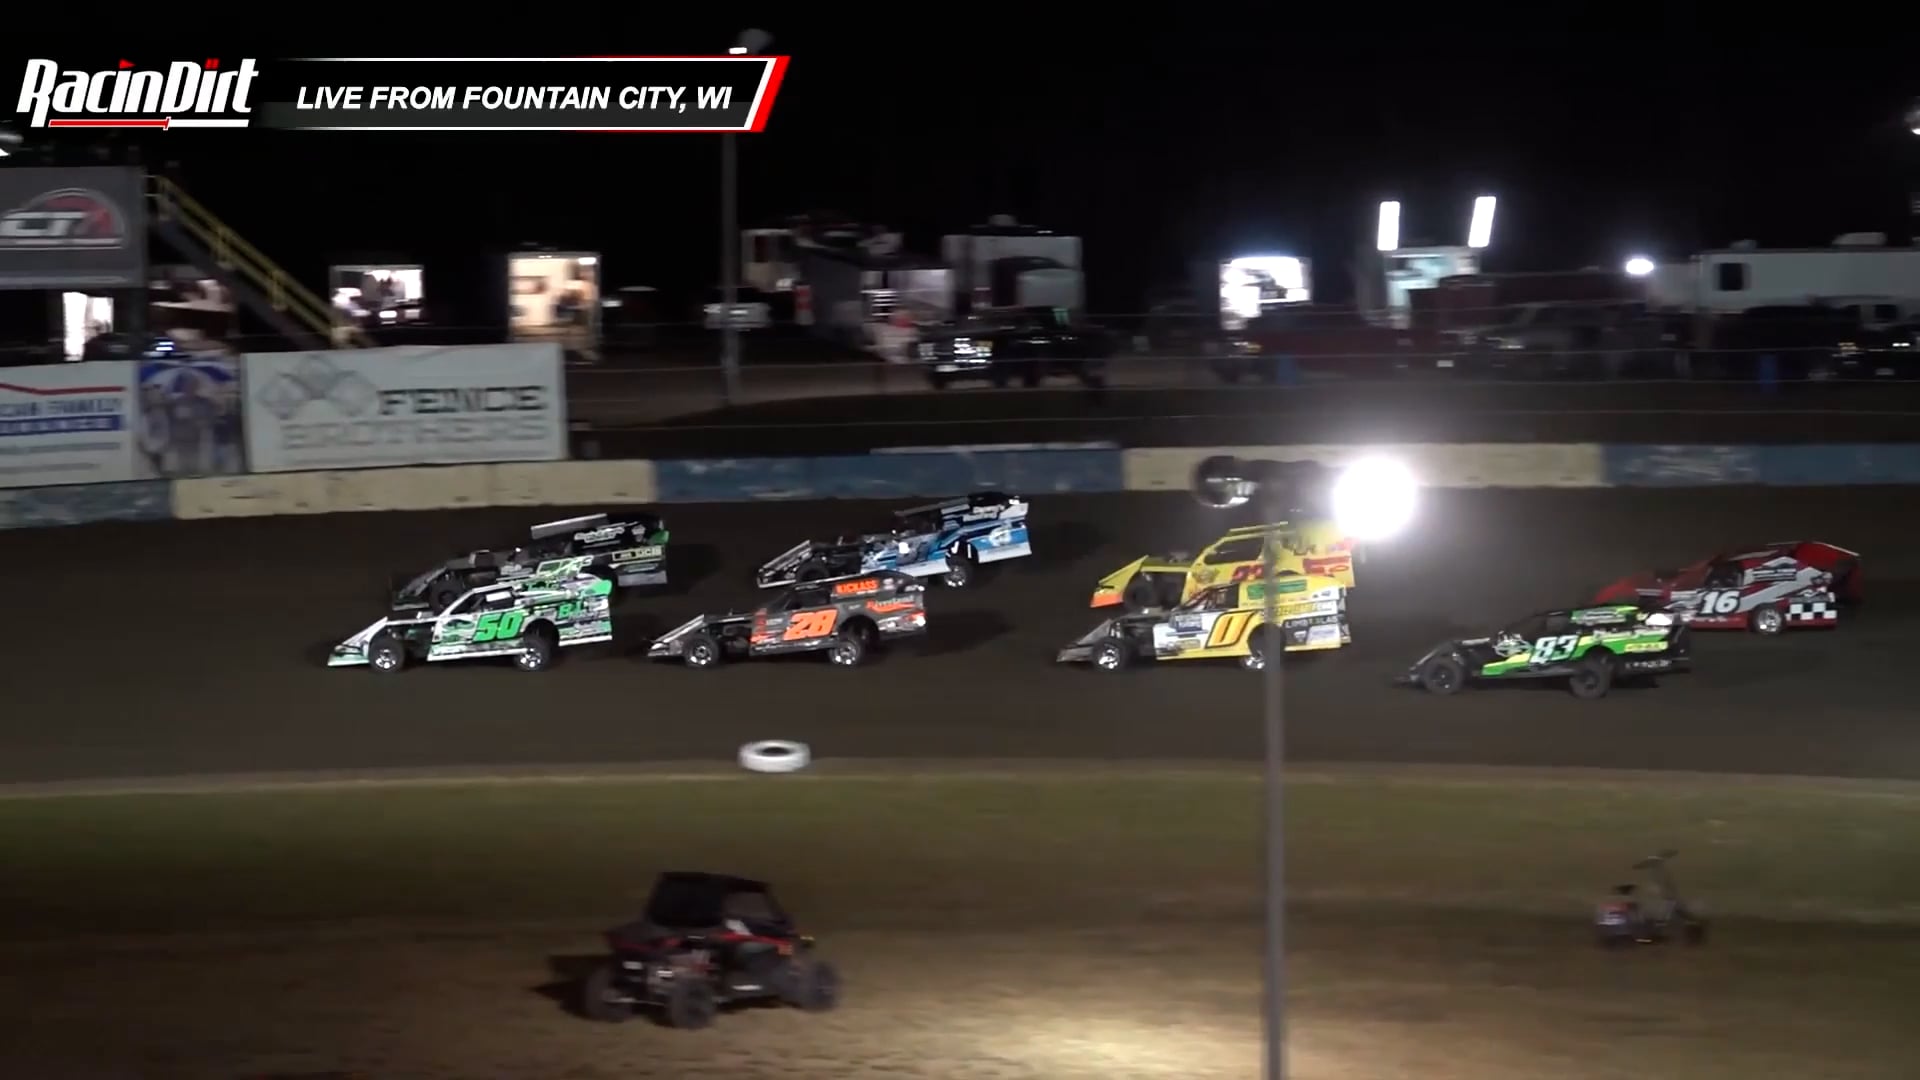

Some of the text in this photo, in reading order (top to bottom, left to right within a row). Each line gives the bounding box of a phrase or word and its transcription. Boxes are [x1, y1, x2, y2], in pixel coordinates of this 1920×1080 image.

[376, 386, 544, 415] FENCE
[1701, 591, 1740, 614] 16
[472, 612, 524, 641] 50
[783, 608, 838, 641] 28
[1530, 635, 1579, 663] 83
